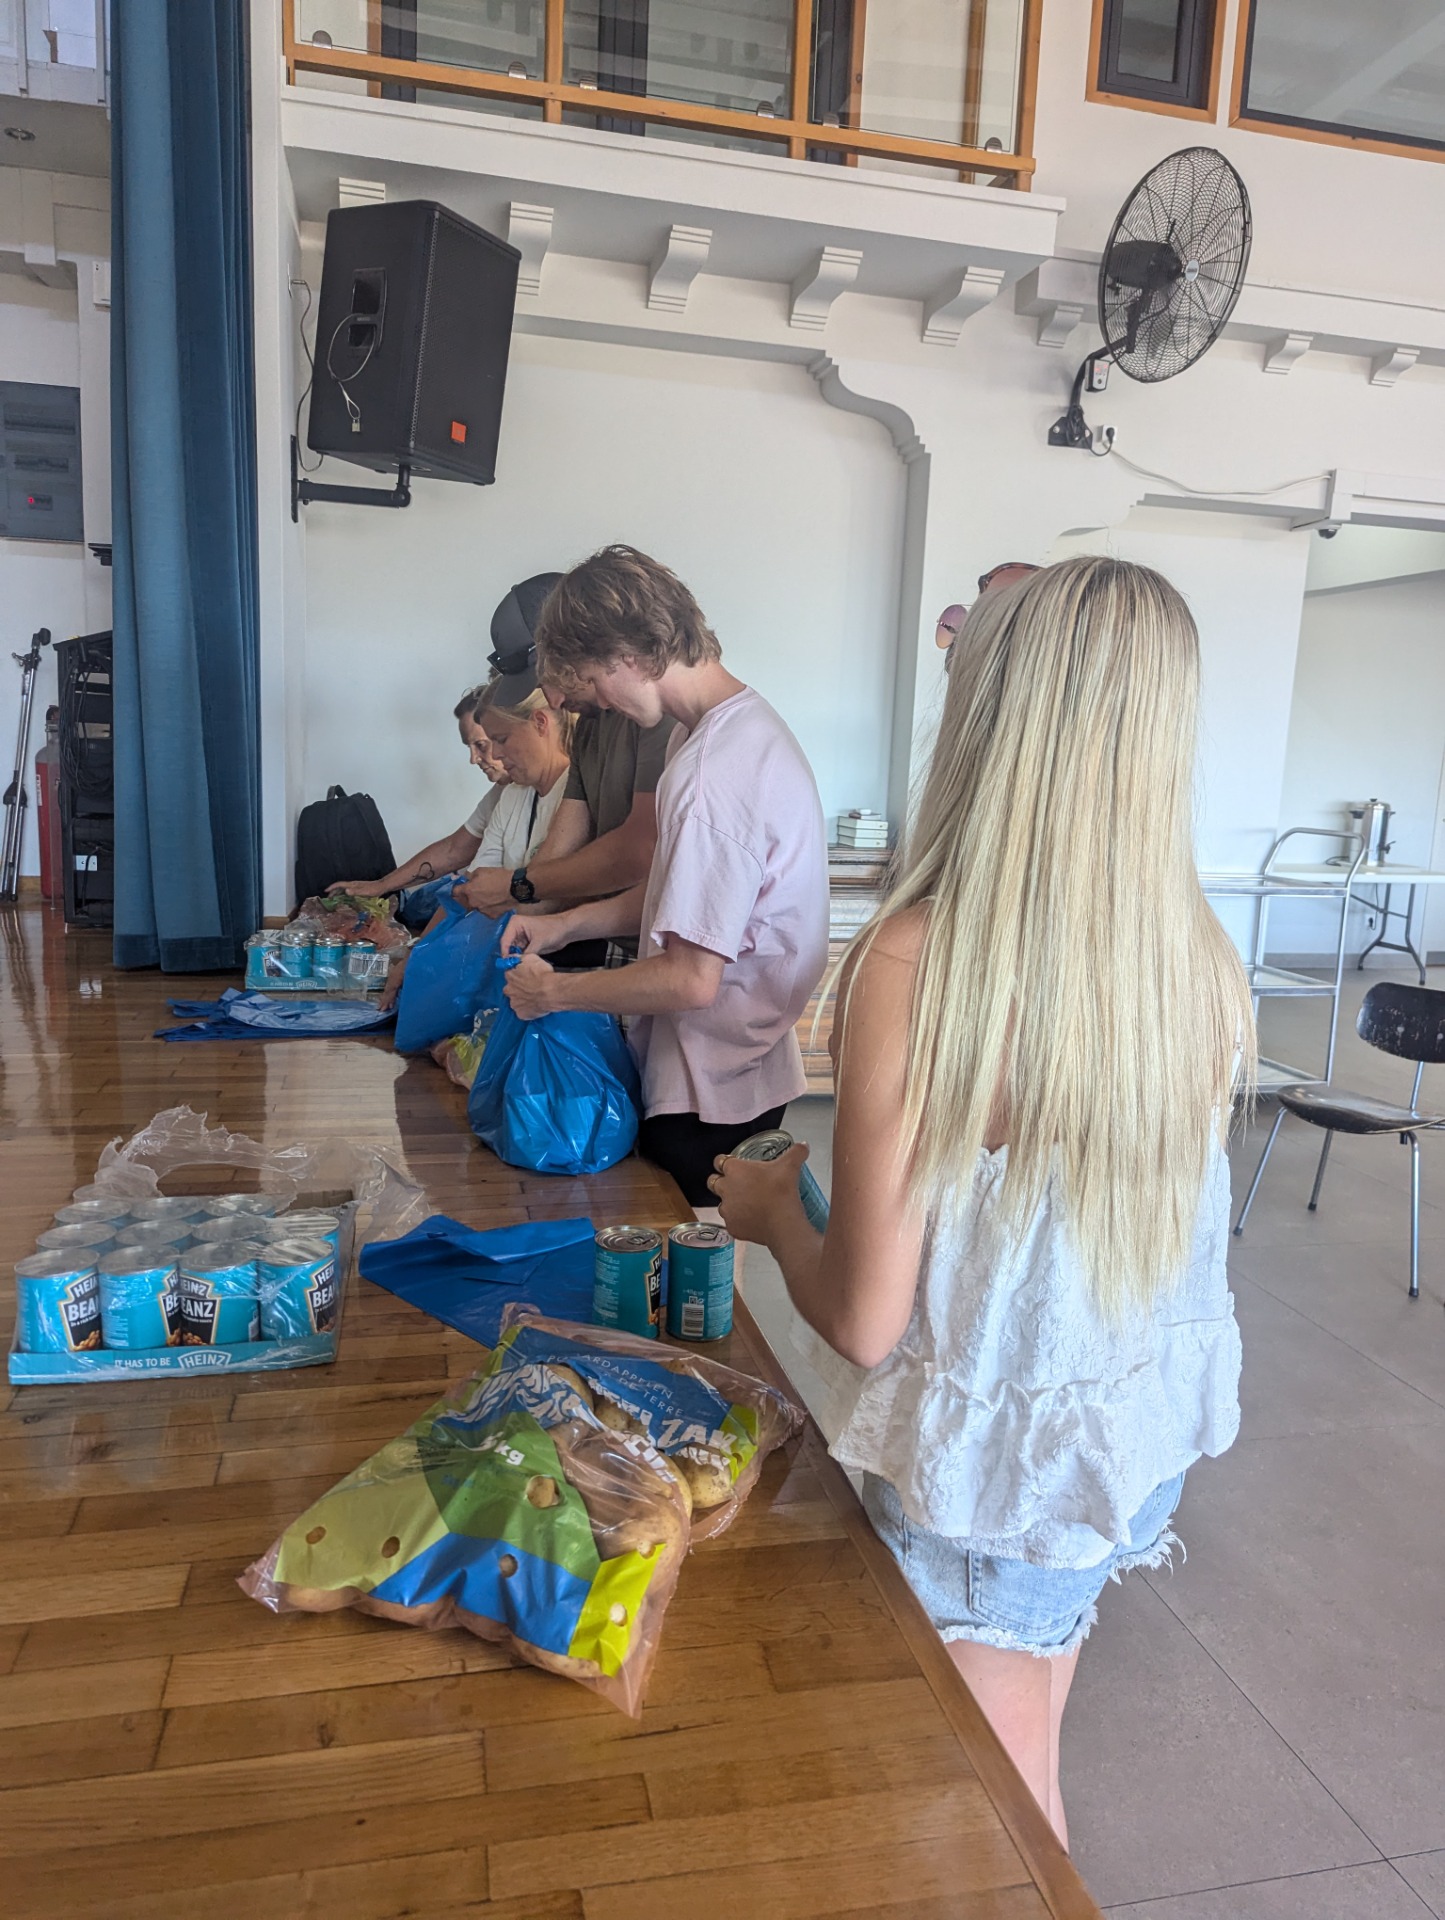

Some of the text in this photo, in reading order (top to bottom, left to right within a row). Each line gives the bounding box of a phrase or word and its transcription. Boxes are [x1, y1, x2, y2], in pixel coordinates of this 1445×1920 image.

[181, 1279, 207, 1296] EINZ
[181, 1297, 213, 1317] EANZ
[114, 1354, 226, 1368] IT HAS TO BE HEINZ
[577, 1354, 674, 1399] ARDAPPELEN
[644, 1391, 685, 1417] TERRE
